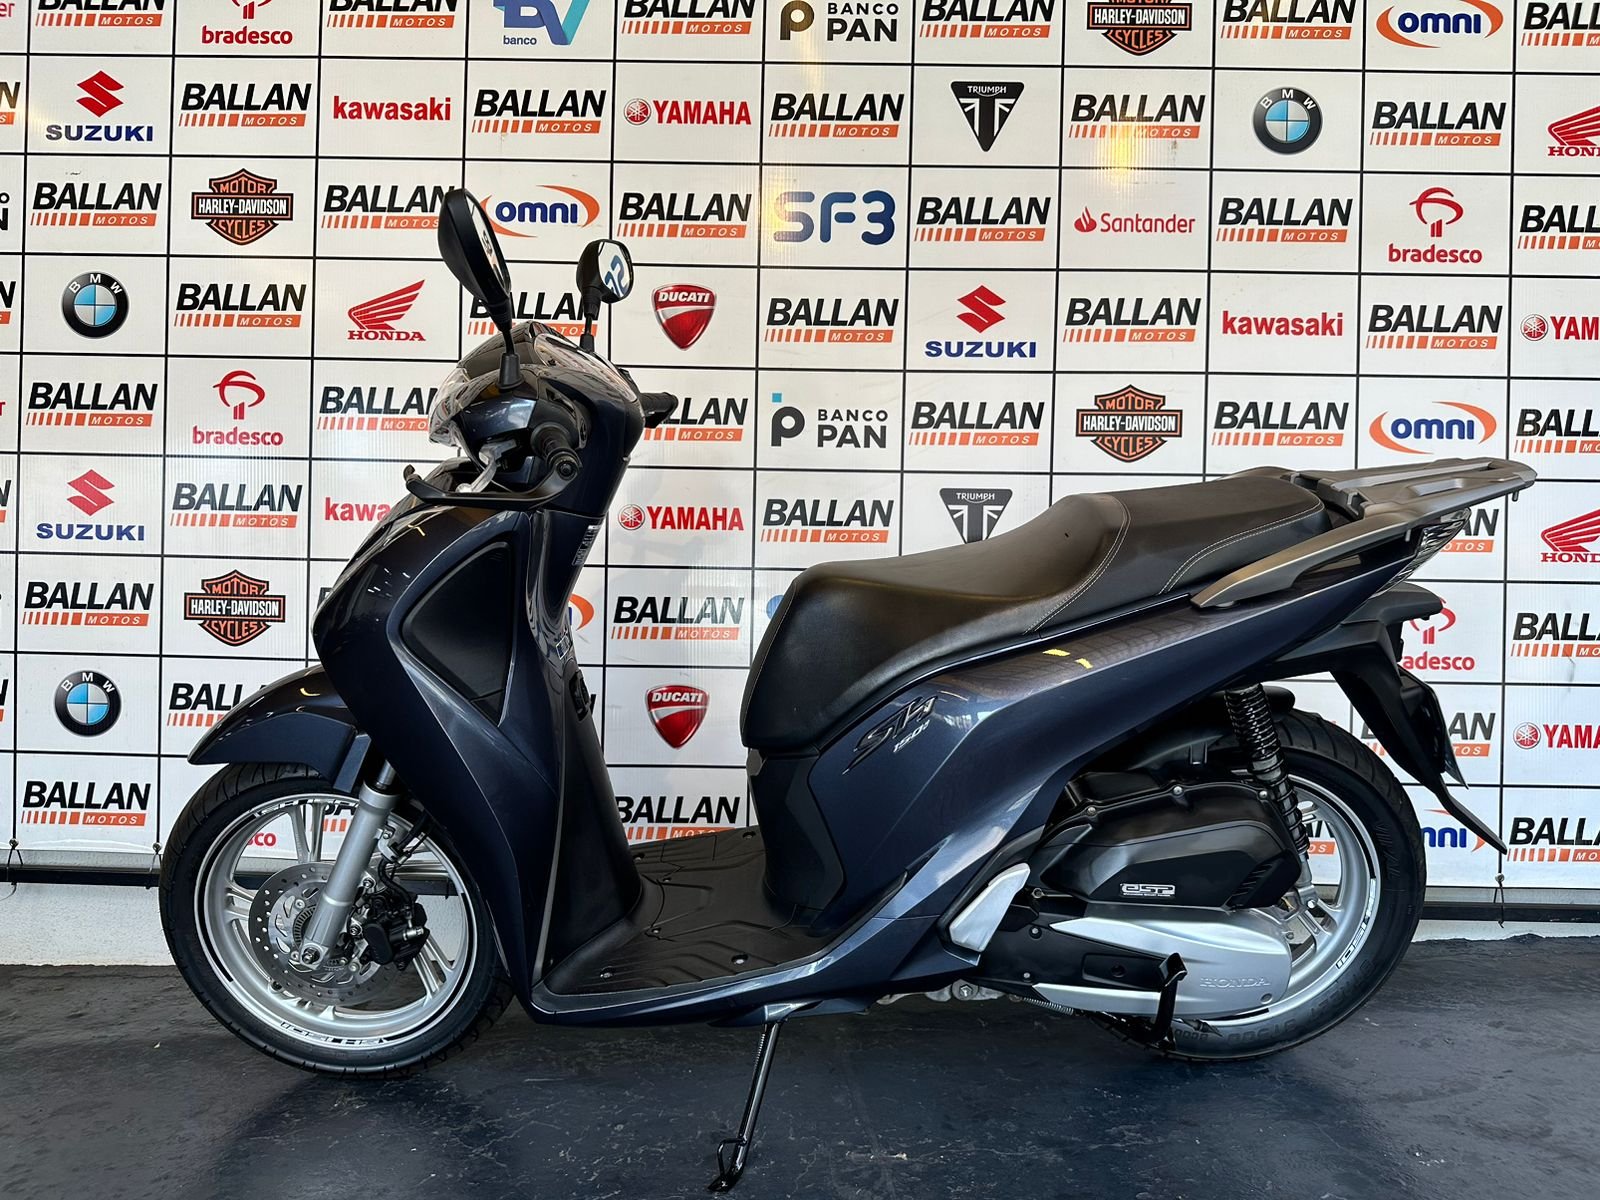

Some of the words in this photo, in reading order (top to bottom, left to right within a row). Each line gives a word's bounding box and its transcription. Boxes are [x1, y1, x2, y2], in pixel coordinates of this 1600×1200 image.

[828, 3, 898, 15] BANCO
[922, 0, 1055, 21] BALLAN
[1094, 7, 1186, 26] HARLEY-DAVIDSON
[1223, 0, 1356, 23] BALLAN
[1524, 3, 1600, 30] BALL
[393, 18, 445, 26] MOTOS
[689, 24, 742, 32] MOTOS
[827, 18, 897, 41] PAN
[1398, 13, 1481, 33] omni
[202, 26, 292, 44] bradesco
[504, 35, 536, 45] banco
[988, 28, 1041, 36] MOTOS
[1109, 29, 1171, 50] CYCLES
[181, 84, 311, 110] BALLAN
[967, 85, 1007, 94] TRIUMPH
[334, 96, 450, 120] kawasaki
[474, 90, 606, 117] BALLAN
[654, 101, 751, 124] YAMAHA
[771, 94, 904, 121] BALLAN
[1071, 95, 1205, 122] BALLAN
[1372, 102, 1506, 129] BALLAN
[46, 125, 153, 142] SUZUKI
[1138, 127, 1191, 136] MOTOS
[1438, 136, 1491, 144] MOTOS
[1549, 145, 1600, 156] HON
[33, 183, 162, 210] BALLAN
[219, 181, 268, 194] MOTOR
[198, 198, 287, 216] HARLEY-DAVIDSON
[496, 202, 577, 223] omni
[619, 193, 751, 221] BALLAN
[917, 197, 1051, 224] BALLAN
[1219, 198, 1353, 226] BALLAN
[94, 215, 147, 224] MOTOS
[773, 190, 896, 246] SF3
[1100, 212, 1196, 233] Santander
[1520, 205, 1600, 233] BALL
[219, 219, 266, 240] CYCLES
[684, 228, 737, 236] MOTOS
[983, 231, 1036, 239] MOTOS
[1389, 244, 1482, 263] bradesco
[176, 284, 306, 311] BALLAN
[658, 291, 710, 303] DUCATI
[767, 298, 899, 326] BALLAN
[1066, 298, 1201, 325] BALLAN
[1368, 305, 1502, 333] BALLAN
[1223, 311, 1342, 335] kawasaki
[1551, 317, 1599, 340] YAM
[347, 329, 426, 341] HONDA
[1133, 332, 1186, 340] MOTOS
[1434, 339, 1488, 347] MOTOS
[924, 340, 1036, 358] SUZUKI
[28, 383, 158, 410] BALLAN
[1105, 399, 1156, 411] MOTOR
[818, 409, 887, 421] BANCO
[911, 402, 1044, 429] BALLAN
[1083, 415, 1176, 432] HARLEY-DAVIDSON
[1214, 402, 1349, 429] BALLAN
[383, 421, 426, 429] MOTO
[1391, 419, 1474, 439] omni
[194, 427, 283, 445] bradesco
[682, 431, 734, 440] MOTOS
[818, 425, 886, 448] PAN
[1281, 436, 1334, 444] MOTOS
[1104, 437, 1154, 458] CYCLES
[173, 483, 302, 511] BALLAN
[956, 492, 995, 501] TRIUMPH
[325, 497, 391, 521] kawa
[647, 507, 743, 530] YAMAHA
[763, 499, 894, 526] BALLAN
[236, 517, 288, 526] MOTOS
[37, 524, 144, 540] SUZUKI
[827, 532, 879, 541] MOTOS
[1443, 542, 1486, 551] OTOS
[1541, 553, 1600, 563] HOND
[24, 582, 154, 610] BALLAN
[212, 584, 259, 596] MOTOR
[190, 599, 280, 617] HARLEY-DAVIDSON
[614, 596, 744, 623] BALLAN
[88, 616, 140, 624] MOTOS
[211, 622, 259, 640] CYCLES
[678, 629, 731, 638] MOTOS
[1402, 652, 1474, 670] adesco
[652, 692, 703, 703] DUCATI
[1543, 724, 1600, 748] YAMA
[23, 781, 151, 810] BALLAN
[85, 815, 137, 824] MOTOS
[1200, 976, 1271, 988] HONDA
